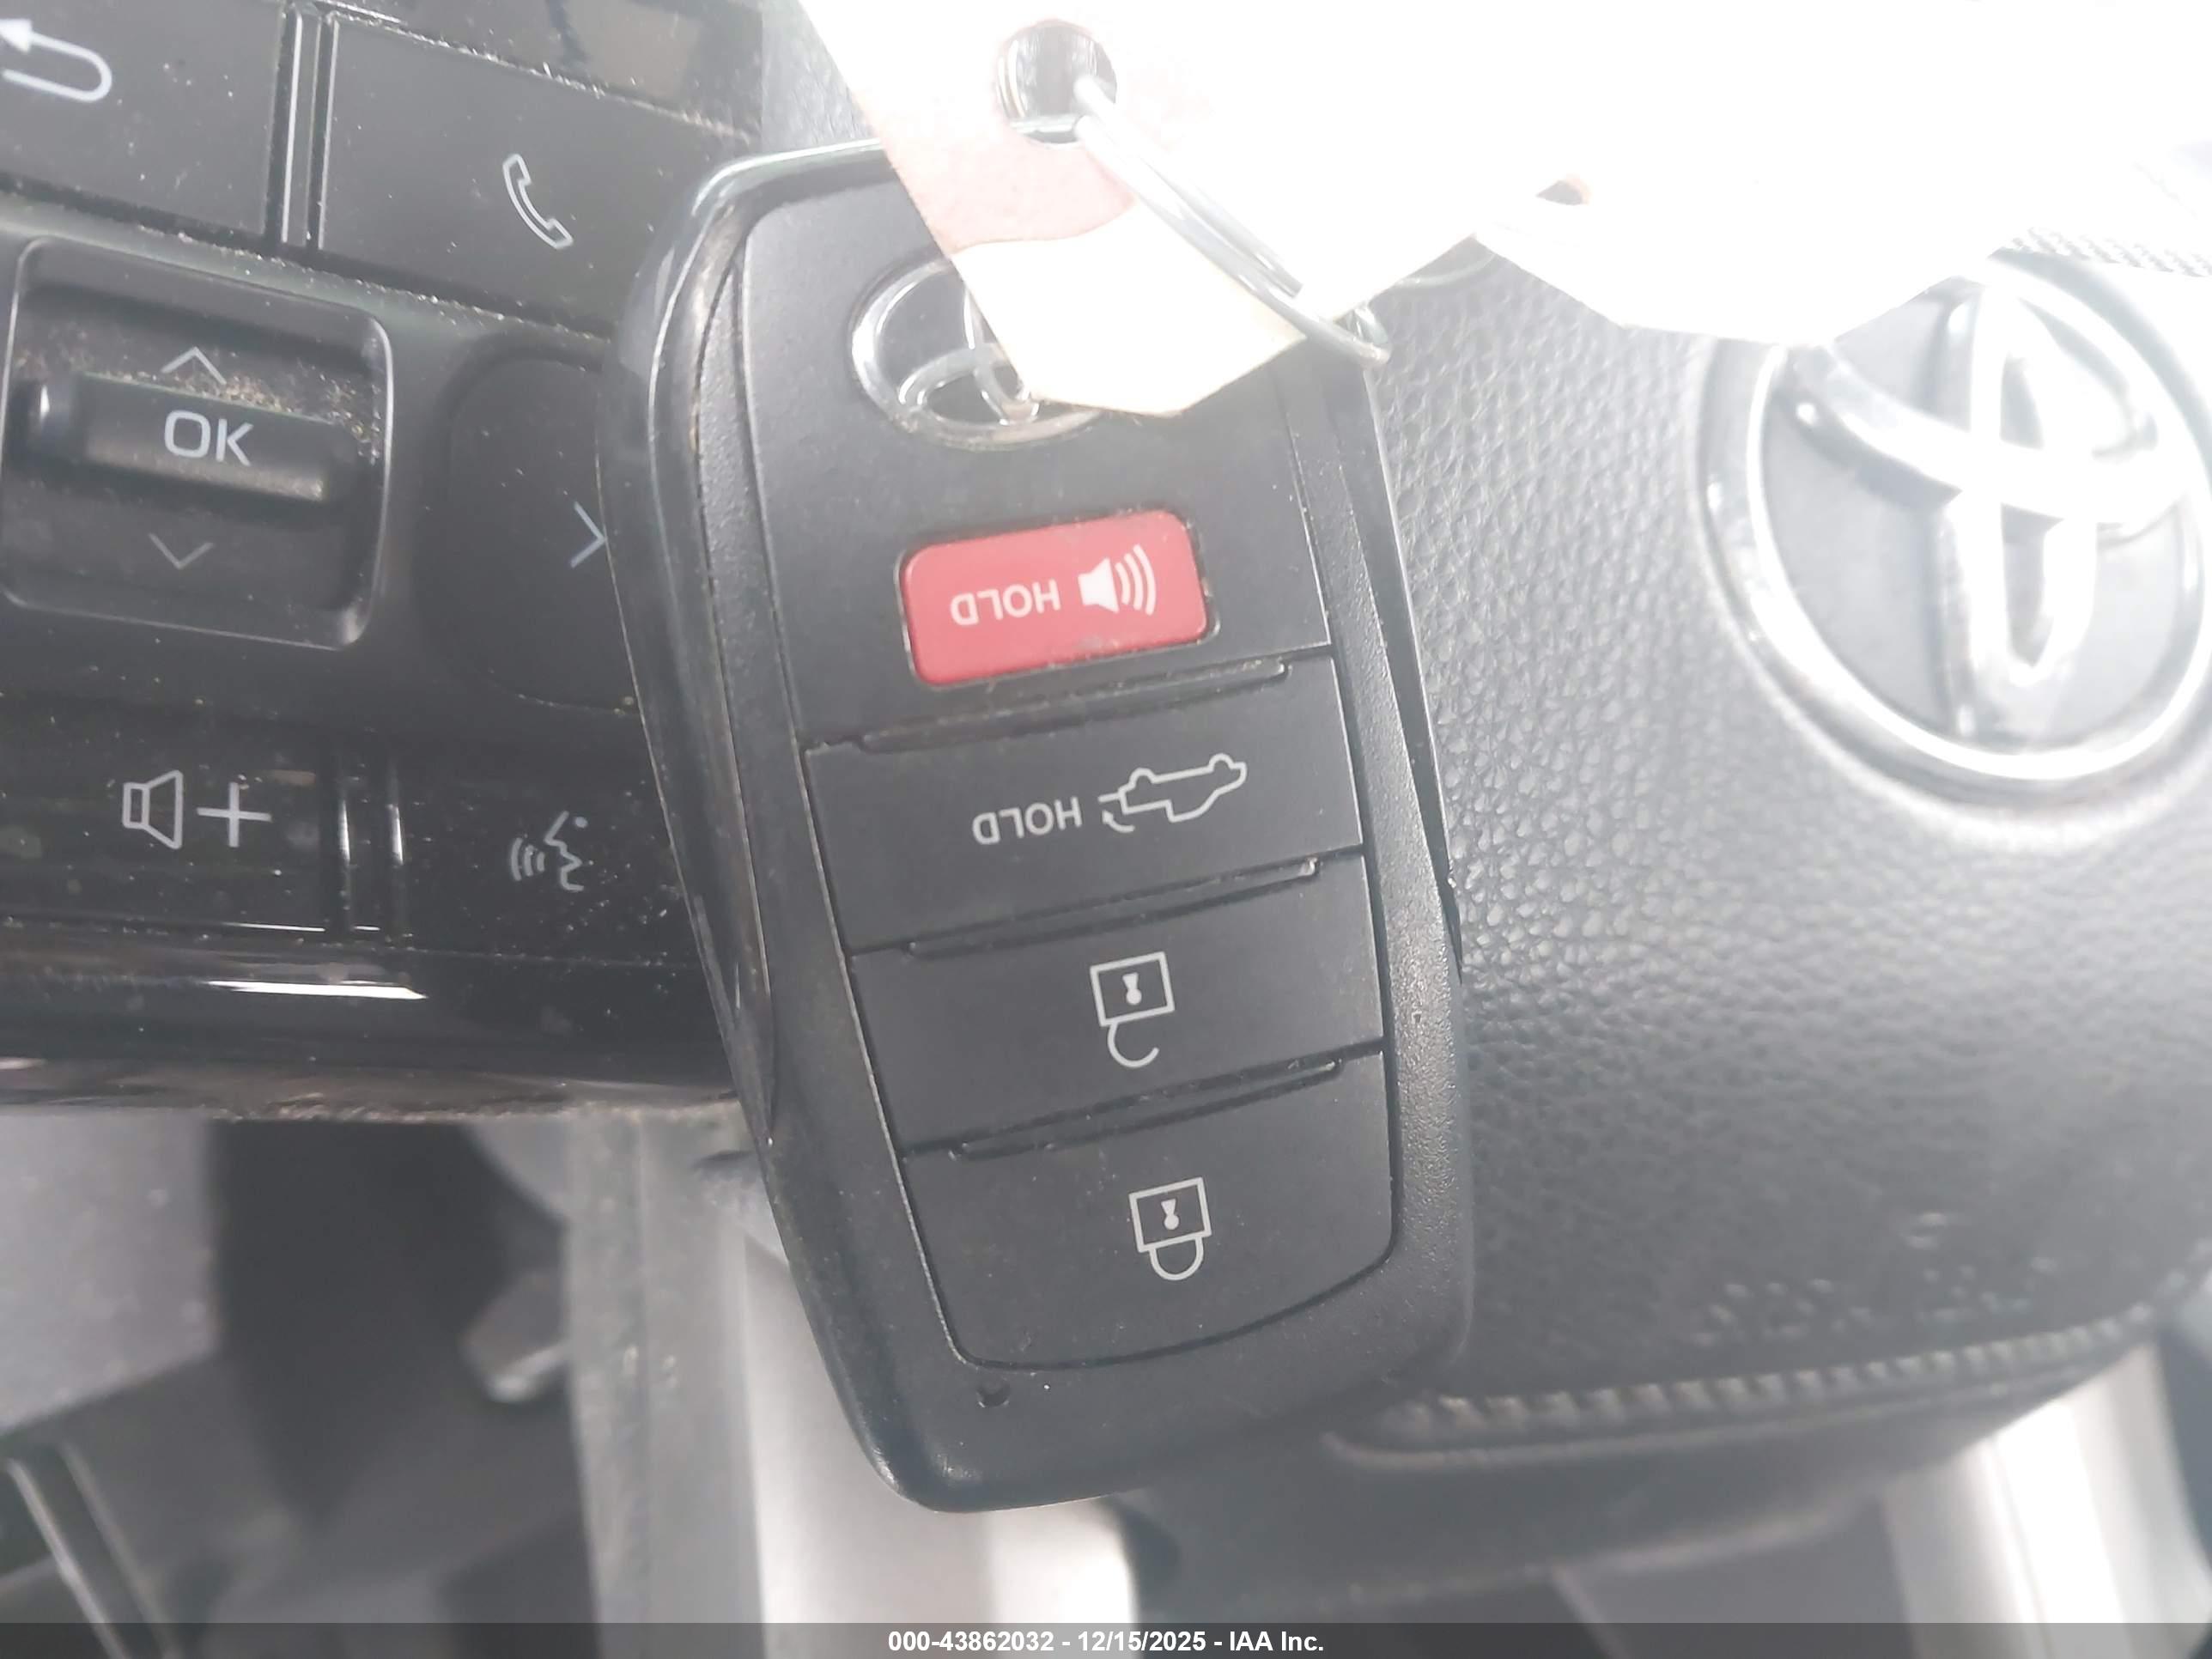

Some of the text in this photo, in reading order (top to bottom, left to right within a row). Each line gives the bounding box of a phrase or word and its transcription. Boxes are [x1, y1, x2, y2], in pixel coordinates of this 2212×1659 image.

[164, 410, 253, 466] OK
[950, 578, 1060, 625] HOLD
[972, 796, 1082, 845] HOLD
